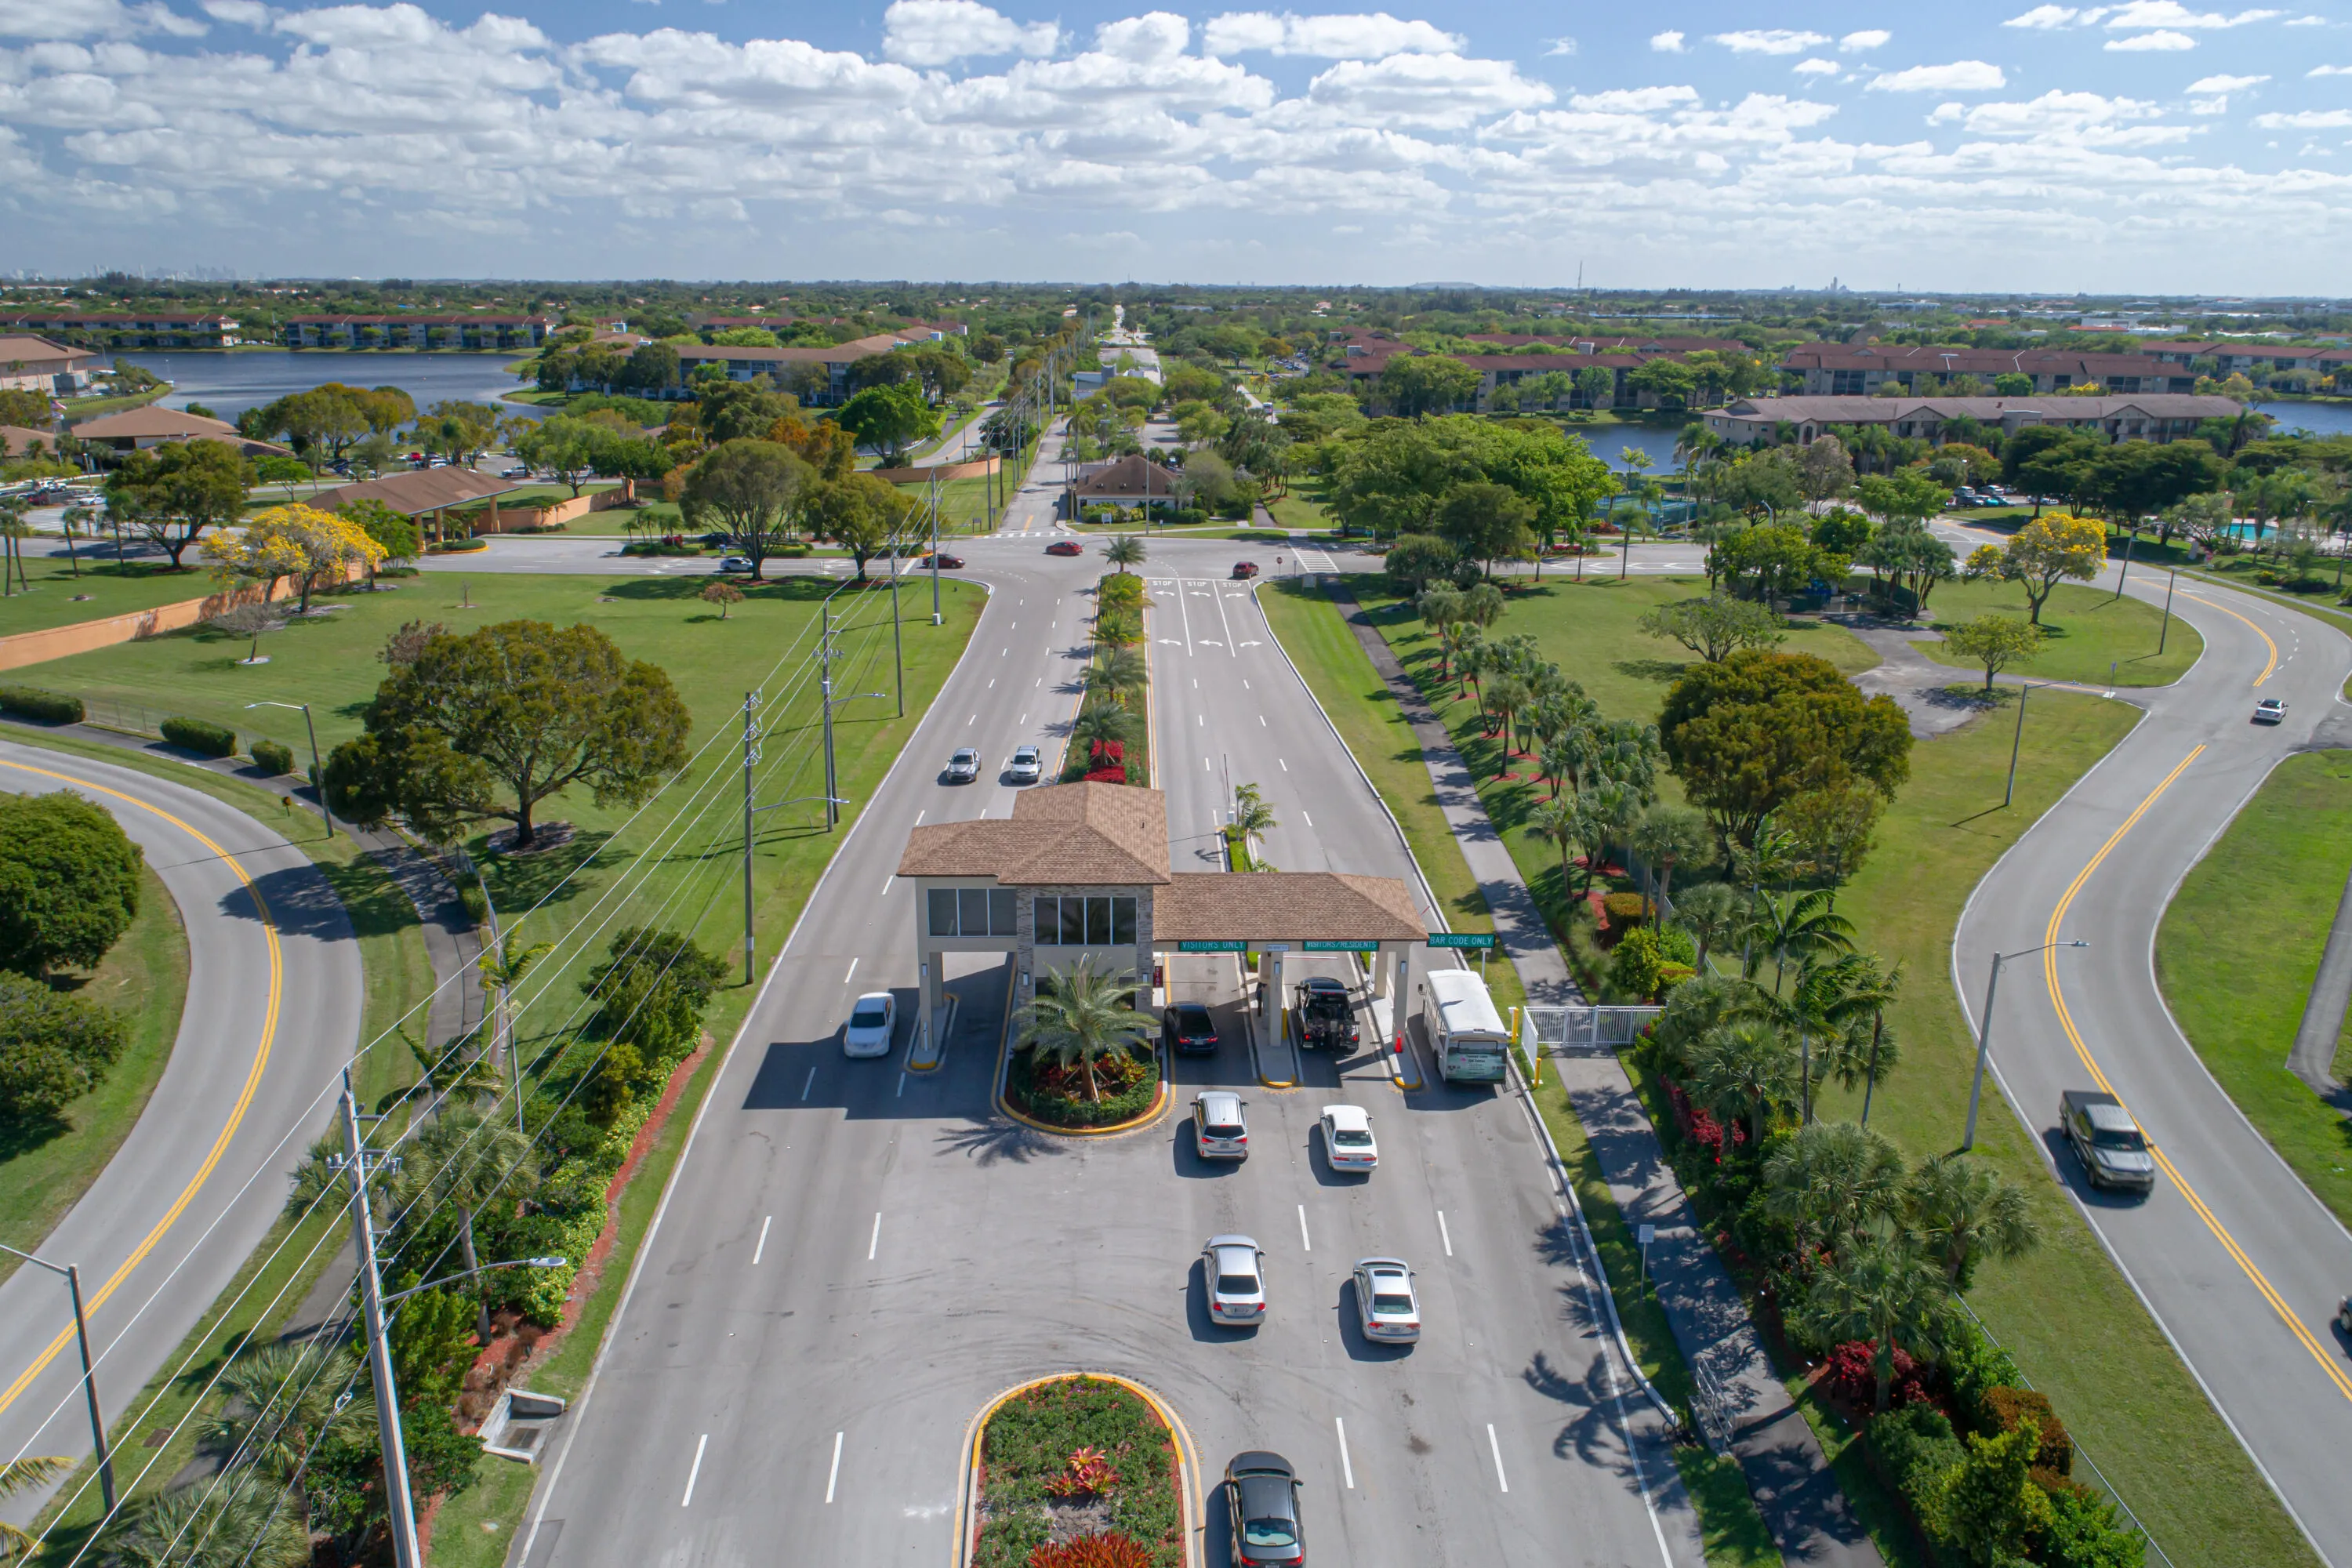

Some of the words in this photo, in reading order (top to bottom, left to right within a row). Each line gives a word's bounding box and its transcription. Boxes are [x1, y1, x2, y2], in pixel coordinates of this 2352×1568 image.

[1429, 935, 1446, 945] BAR
[1448, 936, 1468, 946] CODE
[1471, 937, 1493, 946] ONLY
